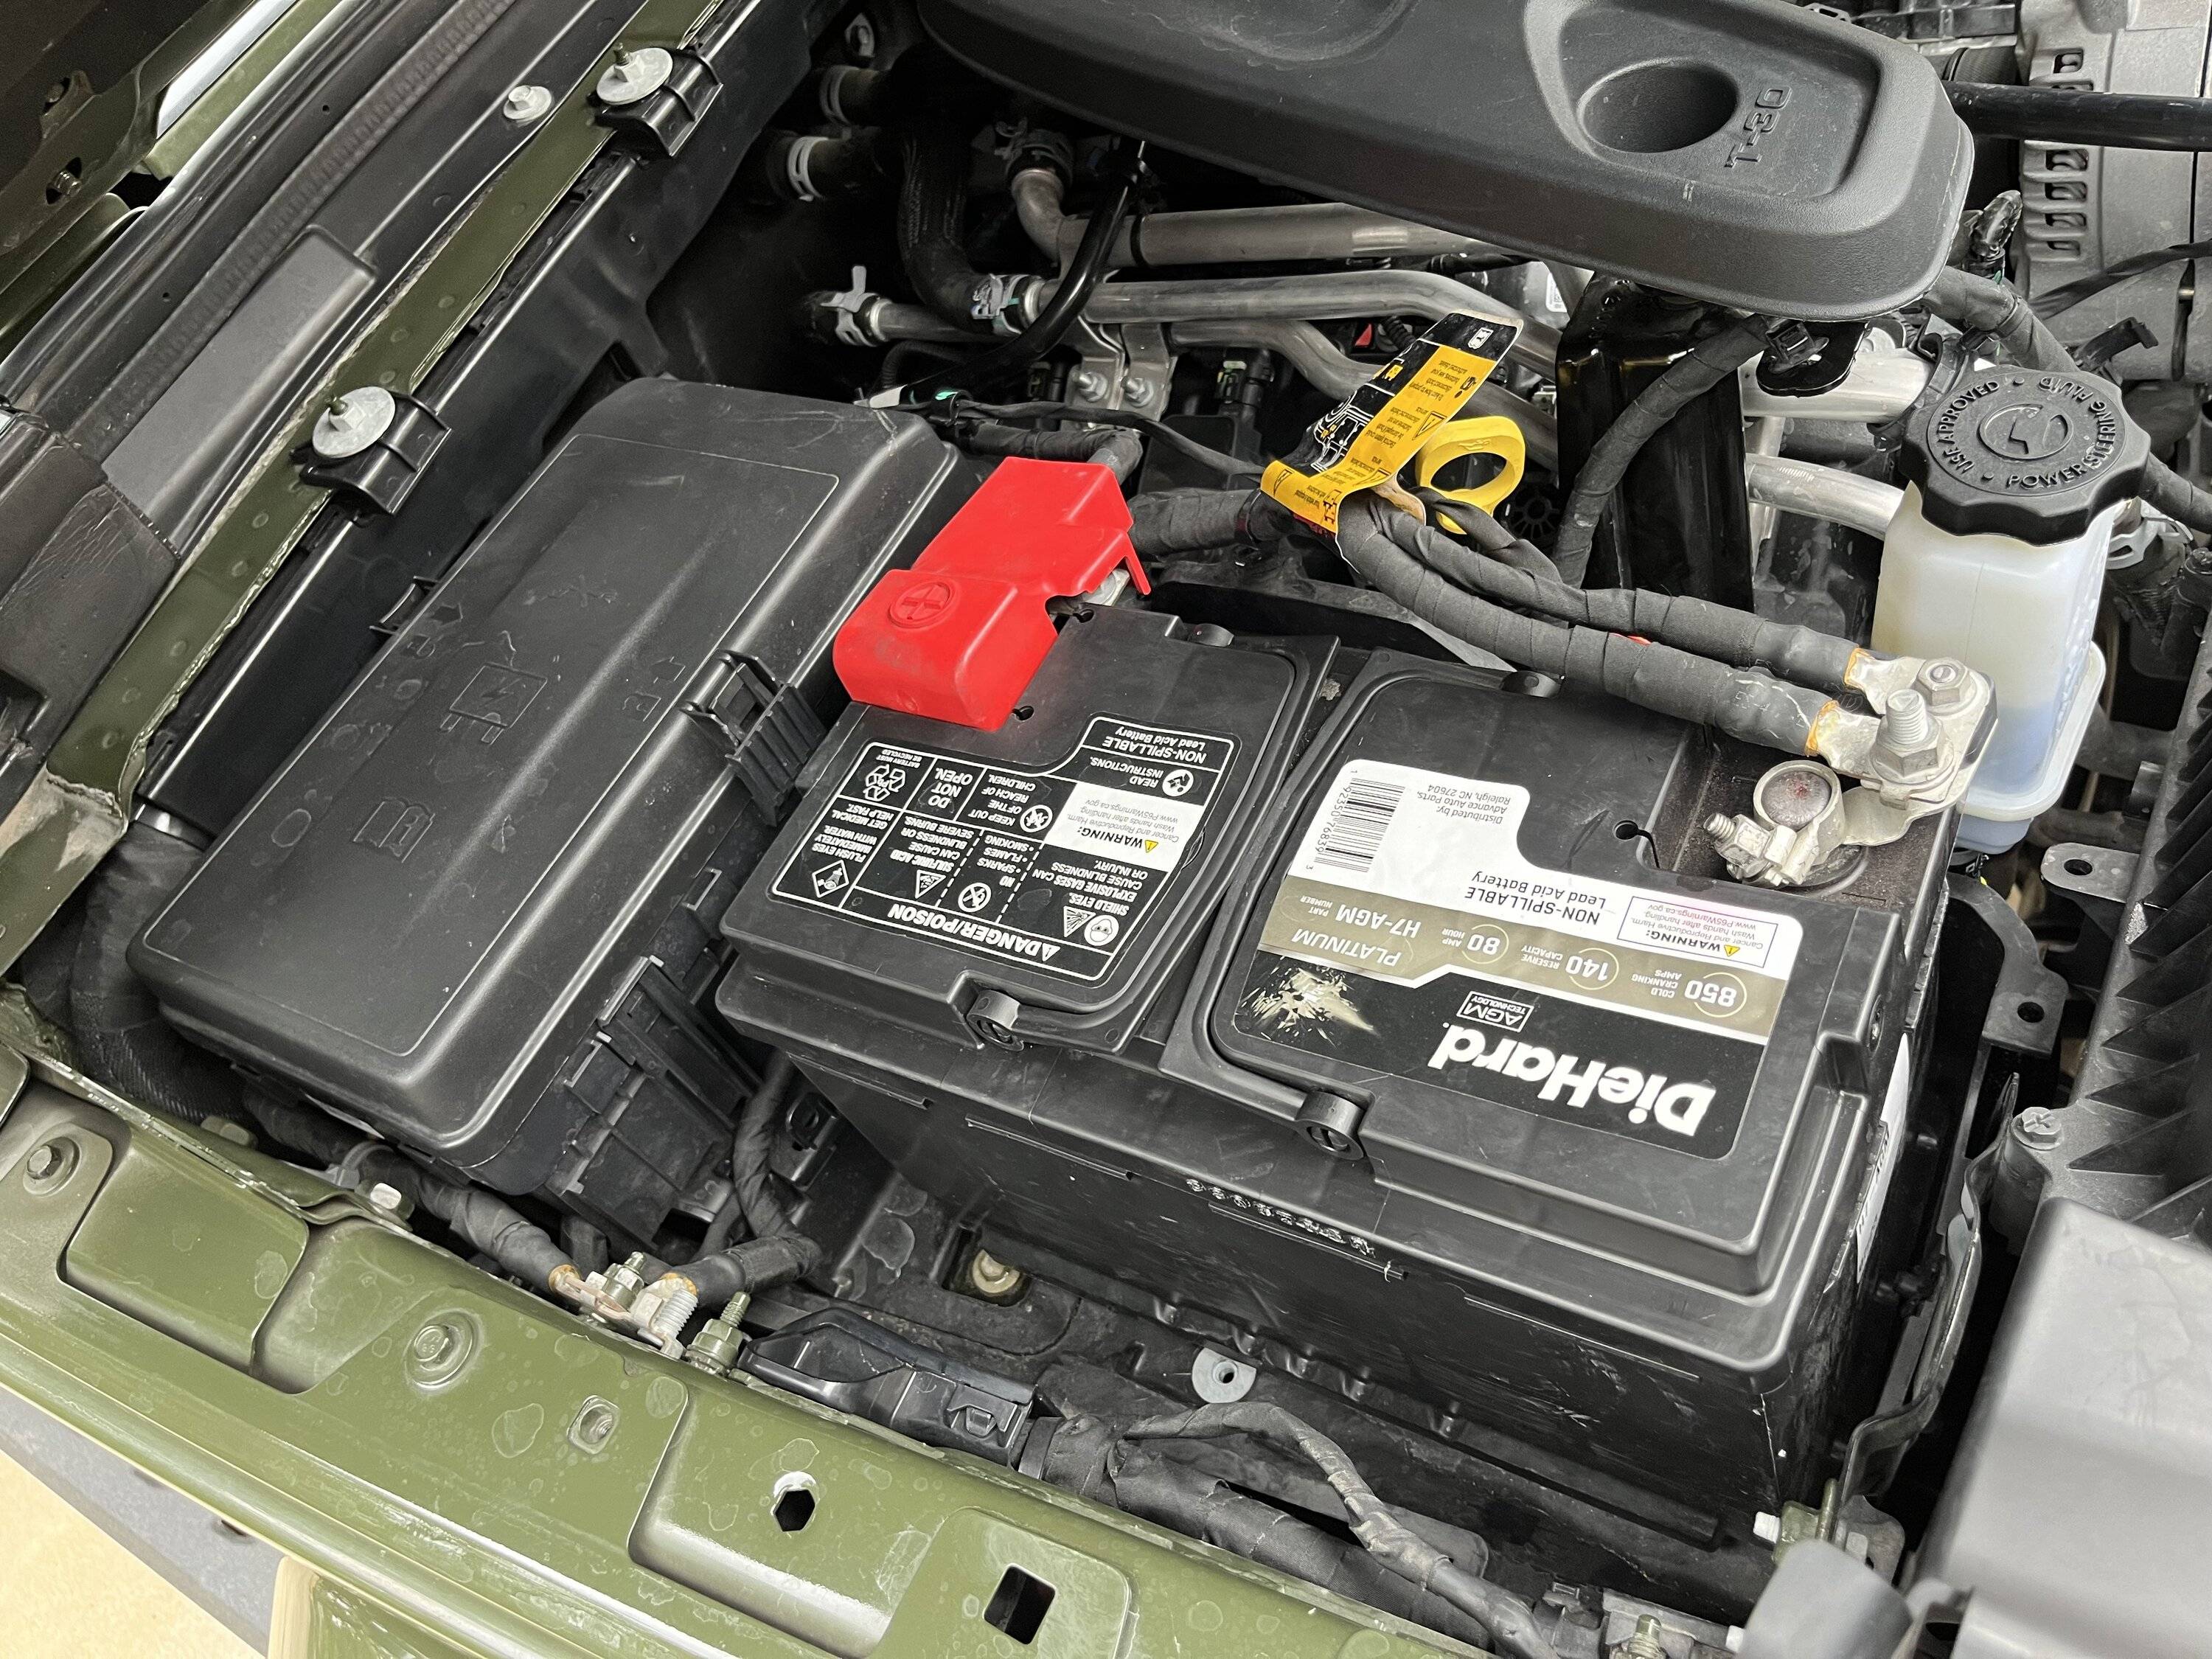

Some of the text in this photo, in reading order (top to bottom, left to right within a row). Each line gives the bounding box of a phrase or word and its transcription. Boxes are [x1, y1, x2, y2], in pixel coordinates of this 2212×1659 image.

[1725, 85, 1791, 168] T-30
[1935, 379, 2000, 476] USE APPROVED
[2006, 375, 2116, 487] POWER STEERING FLUID
[1102, 735, 1208, 765] NON-SPILLABLE
[1114, 726, 1206, 752] Lead Acid Battery
[875, 754, 921, 769] BATTERY MUST
[881, 748, 923, 762] BE RECYCLED
[934, 767, 973, 786] OPEN.
[1089, 756, 1164, 779] INSTRUCTIONS.
[930, 782, 962, 798] NOT
[987, 773, 1037, 792] CHILDREN.
[1129, 775, 1160, 789] READ
[928, 794, 951, 809] DO
[981, 786, 1030, 804] REACH OF
[1416, 790, 1508, 815] Advance Auto Parts,
[1458, 790, 1473, 800] NC
[1475, 791, 1512, 810] Raleigh,
[845, 803, 895, 821] HELP FAST.
[967, 808, 1016, 827] KEEP OUT
[987, 799, 1023, 815] OF THE
[1084, 799, 1179, 824] www.P65Warnings.ca.gov
[1436, 804, 1504, 825] Distributed by:
[831, 809, 888, 830] GET MEDICAL
[904, 815, 975, 840] SEVERE BURNS.
[1067, 813, 1180, 844] Cancer and Reproductive Harm.
[1079, 805, 1175, 834] Wash hands after handling.
[813, 833, 873, 855] IMMEDIATELY
[823, 824, 878, 846] WITH WATER.
[900, 827, 968, 850] BLINDNESS OR
[984, 834, 1030, 852] SMOKING
[1077, 826, 1144, 849] WARNING:
[811, 842, 867, 863] FLUSH EYES
[889, 849, 955, 873] SULFURIC ACID
[908, 841, 961, 860] CAN CAUSE
[983, 846, 1023, 863] FLAMES
[976, 857, 1017, 874] SPARKS
[1050, 861, 1143, 891] CAUSE BLINDNESS
[1093, 859, 1149, 880] OR INJURY.
[998, 874, 1016, 888] NO
[1031, 868, 1138, 903] EXPLOSIVE GASES CAN
[1471, 870, 1607, 910] Lead Acid Battery
[1068, 891, 1130, 917] SHIELD EYES.
[1299, 894, 1334, 909] NUMBER
[1307, 905, 1329, 917] PART
[1464, 886, 1601, 925] NON-SPILLABLE
[886, 903, 1043, 957] DANGER/POISON
[1335, 903, 1422, 939] H7-AGM
[1644, 910, 1756, 941] Wash hands after handling.
[1646, 904, 1756, 936] www.P65Warnings.ca.gov
[1441, 928, 1466, 939] HOUR
[1441, 937, 1463, 947] AMP
[1467, 933, 1501, 956] 80
[1630, 917, 1764, 950] Cancer and Reproductive Harm.
[1645, 930, 1721, 952] WARNING:
[1291, 928, 1402, 967] PLATINUM
[1520, 945, 1564, 961] CAPACITY
[1520, 953, 1561, 970] RESERVE
[1565, 955, 1609, 981] 140
[1630, 973, 1679, 990] CRANKING
[1654, 969, 1683, 981] AMPS
[1469, 992, 1529, 1015] TECHNOLOGY
[1650, 987, 1676, 999] COLD
[1683, 979, 1738, 1008] 850
[1461, 1001, 1525, 1031] AGM
